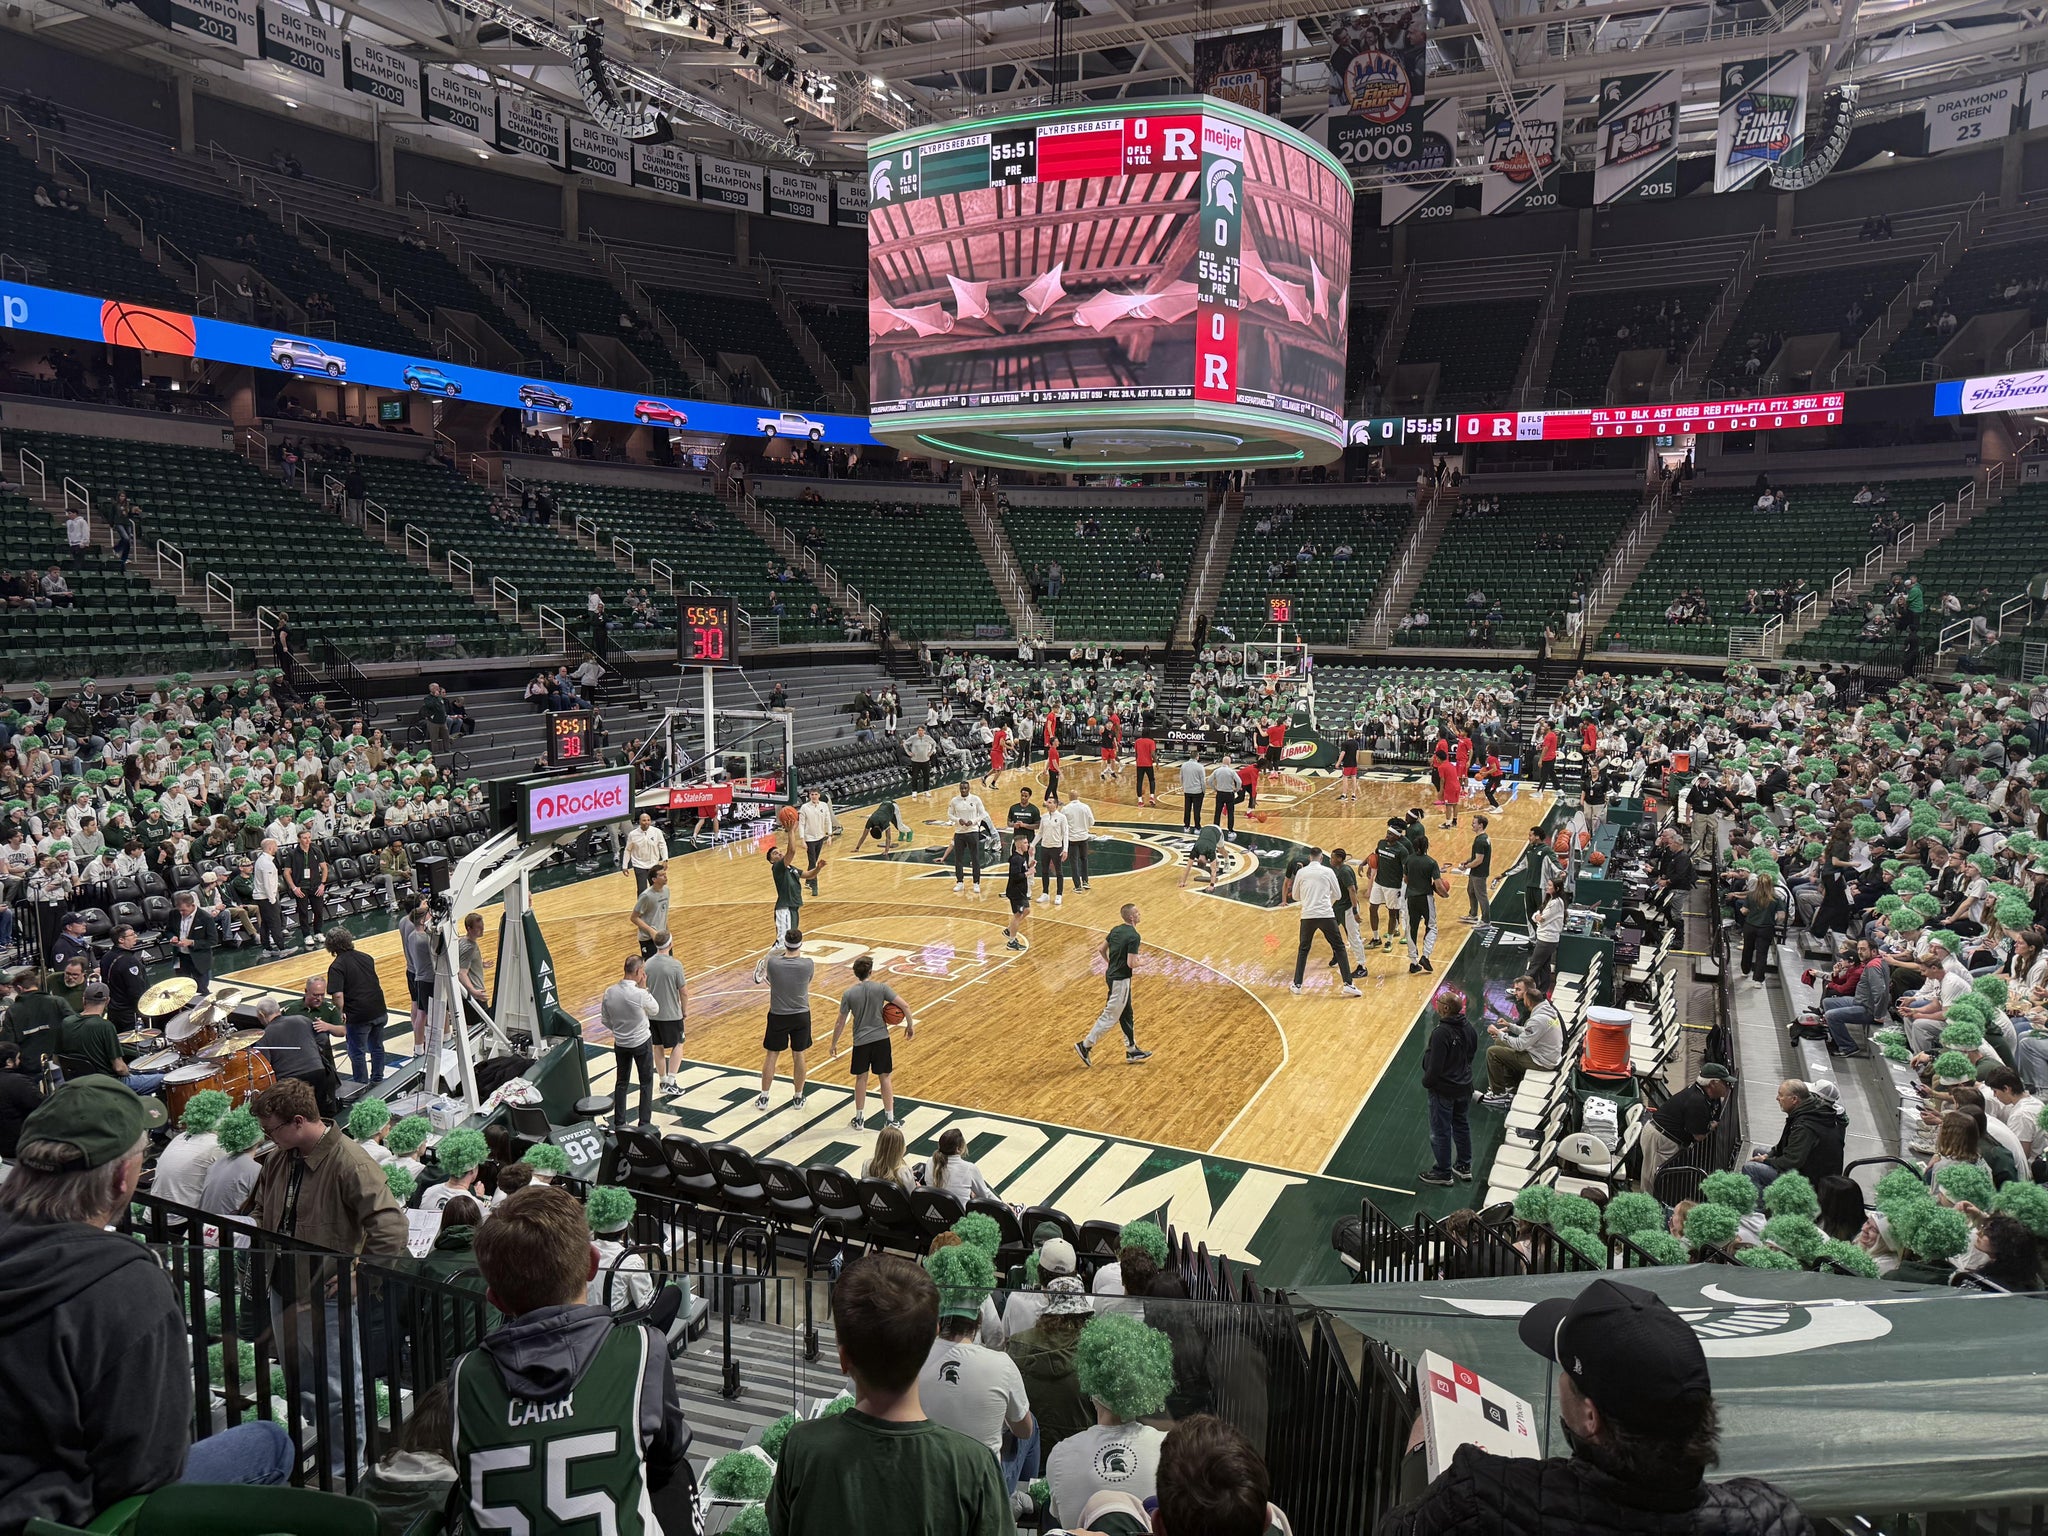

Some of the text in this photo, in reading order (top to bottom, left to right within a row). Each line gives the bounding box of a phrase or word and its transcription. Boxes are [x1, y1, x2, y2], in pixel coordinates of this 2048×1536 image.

[199, 17, 233, 40] 2012
[281, 13, 326, 40] BIG TEN
[268, 23, 340, 60] CHAMPIONS
[290, 51, 322, 73] 2010
[365, 47, 406, 72] BIG TEN
[353, 58, 418, 90] CHAMPIONS
[1219, 74, 1252, 86] NCAA
[371, 82, 403, 101] 2009
[442, 77, 482, 101] BIG TEN
[430, 87, 494, 118] CHAMPIONS
[1937, 89, 2008, 114] DRAYMOND
[449, 110, 478, 131] 2001
[508, 111, 558, 135] TOURNAMENT
[1627, 106, 1671, 134] FINAL
[1740, 110, 1788, 130] FINAL
[1950, 106, 1991, 122] GREEN
[508, 121, 559, 145] CHAMPIONS
[1059, 124, 1076, 134] PTS
[1078, 122, 1094, 133] REB
[1095, 121, 1111, 131] AST
[1134, 119, 1147, 139] 0
[1338, 123, 1412, 141] CHAMPIONS
[1736, 125, 1785, 146] FOUR
[1956, 123, 1982, 142] 23
[517, 136, 549, 157] 2000
[583, 128, 618, 147] BIG TEN
[937, 142, 951, 152] PTS
[952, 140, 965, 149] REB
[966, 137, 980, 147] AST
[1162, 128, 1198, 161] R
[1204, 126, 1242, 151] meijer
[572, 138, 629, 161] CHAMPIONS
[992, 141, 1034, 161] 55:51
[1127, 145, 1151, 156] 0 FLS
[1338, 135, 1412, 164] 2000
[586, 157, 615, 175] 2000
[642, 153, 689, 172] TOURNAMENT
[902, 150, 912, 170] 0
[1134, 155, 1151, 165] TOL
[642, 163, 690, 181] CHAMPIONS
[715, 164, 750, 178] BIG TEN
[1005, 164, 1022, 176] PRE
[1021, 175, 1037, 184] POSS
[653, 176, 679, 193] 1999
[704, 173, 762, 192] CHAMPIONS
[783, 177, 817, 191] BIG TEN
[900, 176, 912, 186] FLS
[900, 185, 912, 194] TOL
[991, 179, 1006, 187] POSS
[1640, 183, 1672, 196] 2015
[721, 190, 745, 204] 1999
[772, 186, 828, 203] CHAMPIONS
[850, 187, 866, 197] BIG
[1525, 194, 1557, 207] 2010
[788, 203, 812, 216] 1998
[1420, 205, 1453, 218] 2009
[1215, 219, 1228, 247] 0
[1199, 251, 1210, 259] FLS
[1199, 261, 1238, 285] 55:51
[1212, 282, 1227, 295] PRE
[1212, 313, 1225, 341] 0
[1204, 354, 1229, 390] R
[992, 395, 1019, 403] EASTERN
[1592, 411, 1609, 422] STL
[1615, 411, 1626, 420] TO
[1631, 410, 1649, 419] BLK
[1654, 408, 1672, 418] AST
[1675, 407, 1699, 417] OREB
[1704, 405, 1721, 415] REB
[1724, 403, 1766, 414] FTM-FTA
[1770, 401, 1788, 411] FT%
[1793, 398, 1817, 409] 3FG%
[1823, 396, 1841, 407] FG%
[1407, 418, 1451, 433] 55:51
[1468, 418, 1479, 435] 0
[1492, 418, 1512, 436] R
[1528, 415, 1541, 423] FLS
[1597, 412, 1834, 435] 0 0 0 0 0 0 0 0 0
[1382, 422, 1394, 438] 0
[1421, 434, 1437, 443] PRE
[1271, 599, 1291, 607] 55:51
[687, 607, 727, 625] 55:51
[1272, 608, 1288, 621] 30
[694, 628, 723, 659] 30
[556, 719, 587, 735] 55:51
[1175, 731, 1205, 741] Rocket
[563, 736, 580, 757] 30
[1280, 744, 1314, 761] LIBMAN
[556, 785, 622, 817] Rocket
[558, 1128, 592, 1142] SWEEP
[564, 1135, 603, 1166] 92
[508, 1391, 574, 1427] CARR
[1516, 1401, 1524, 1422] Photo
[469, 1431, 617, 1536] 55
